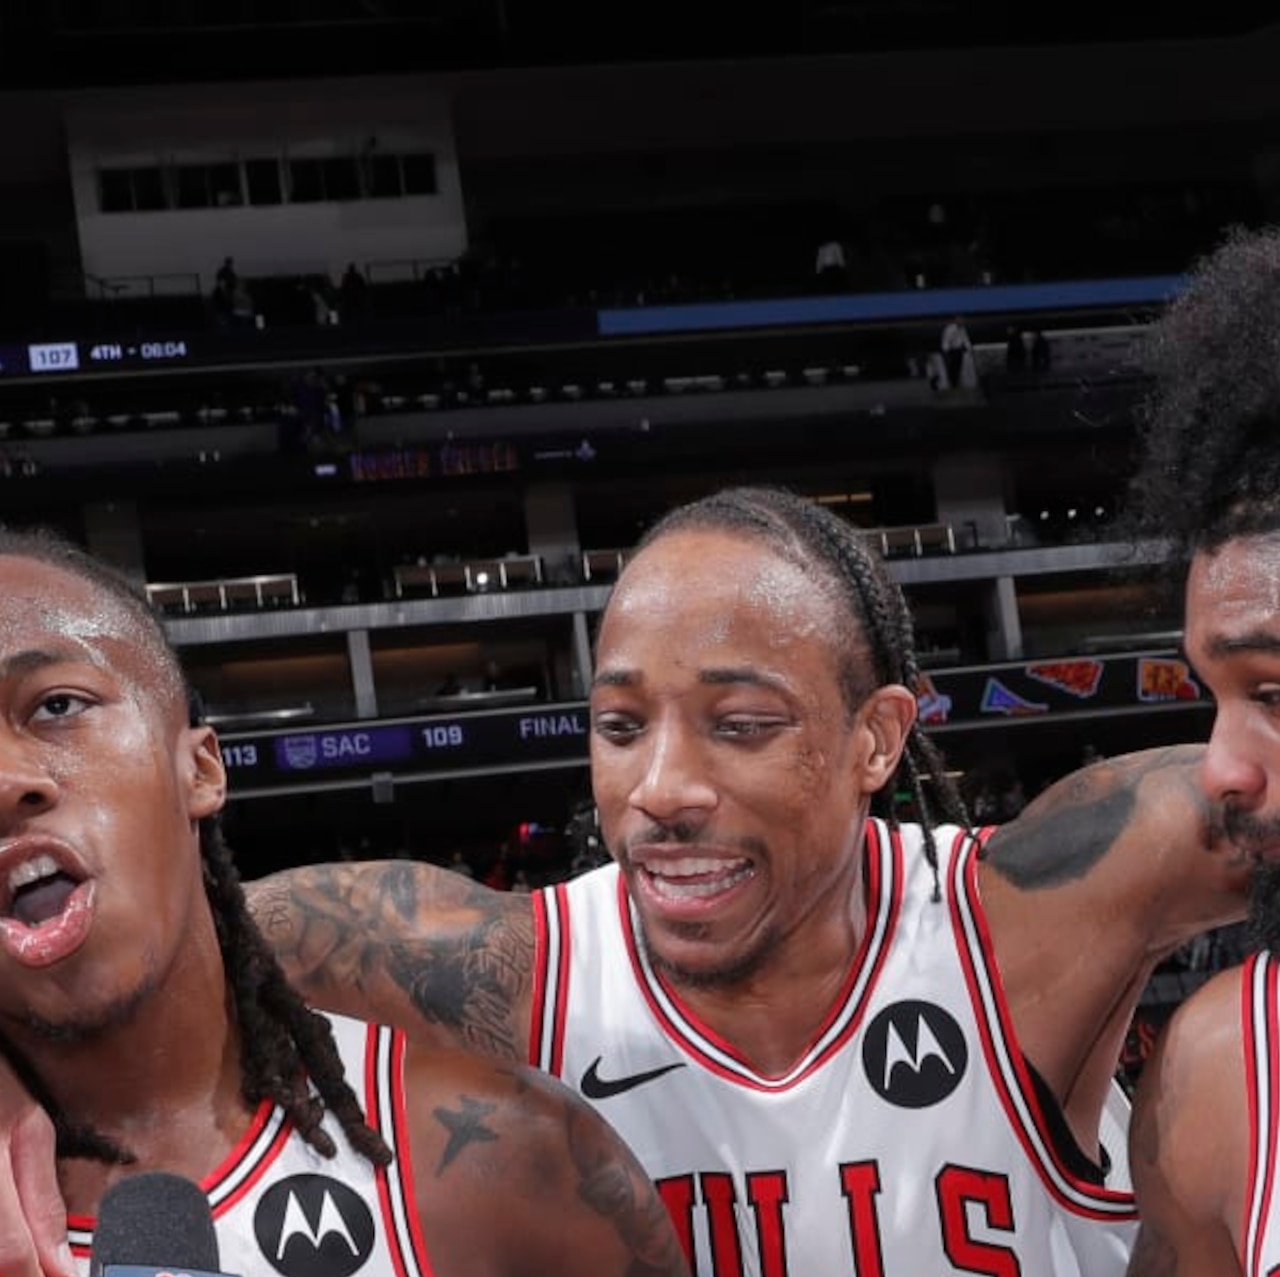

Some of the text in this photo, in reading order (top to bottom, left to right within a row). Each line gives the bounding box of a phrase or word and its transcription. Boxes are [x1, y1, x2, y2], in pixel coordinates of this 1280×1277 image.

[39, 350, 71, 365] 107
[91, 344, 122, 360] 4TH
[222, 715, 584, 766] 113 SAC 109 FINAL
